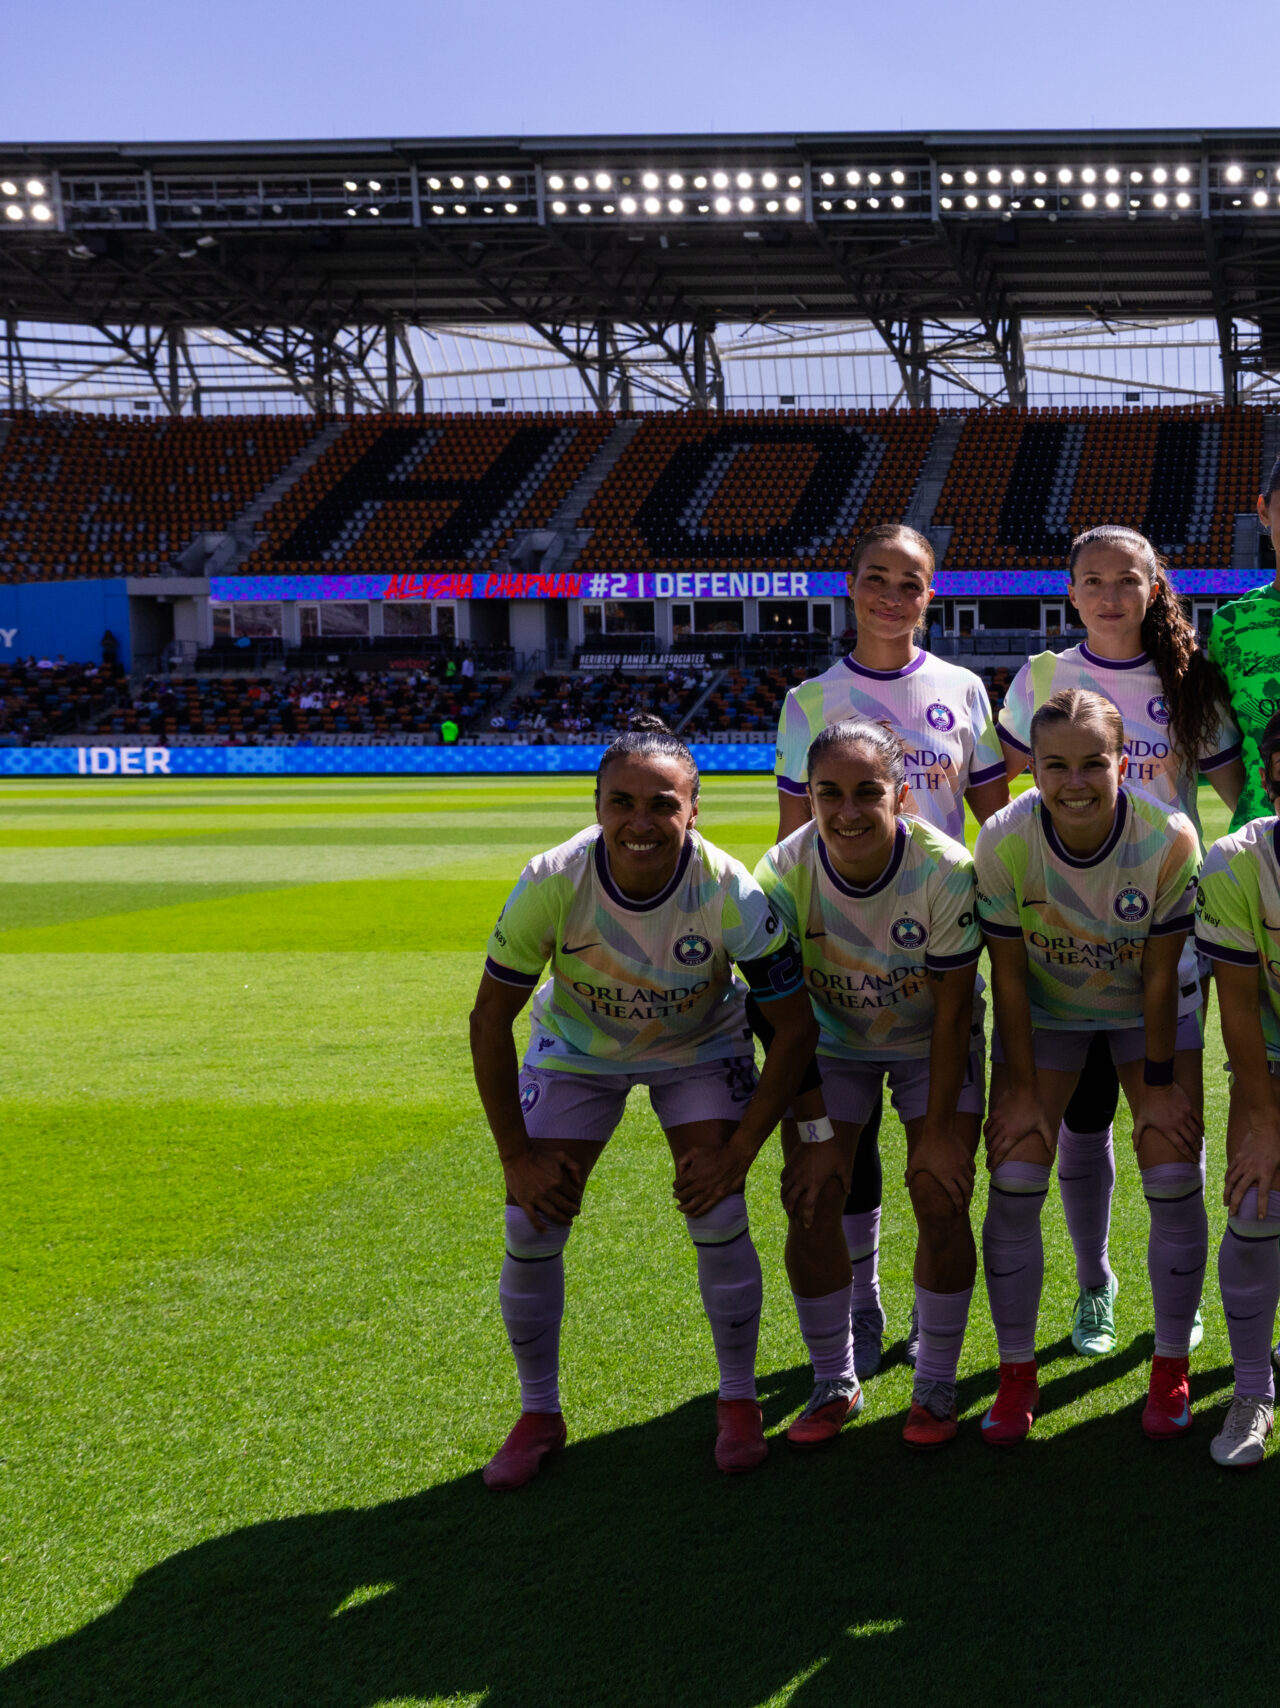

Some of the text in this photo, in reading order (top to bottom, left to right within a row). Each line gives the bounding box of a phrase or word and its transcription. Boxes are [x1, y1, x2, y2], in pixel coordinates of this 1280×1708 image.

[383, 573, 473, 599] ALLYSHA
[485, 573, 582, 598] CHAPMAN
[589, 572, 628, 598] #2
[655, 571, 809, 598] DEFENDER
[1029, 931, 1148, 958] ORLANDO
[1045, 949, 1133, 971] HEALTH
[809, 966, 929, 991] ORLANDO
[573, 980, 710, 1003] ORLANDO
[824, 980, 921, 1009] HEALTH
[590, 999, 695, 1020] HEALTH
